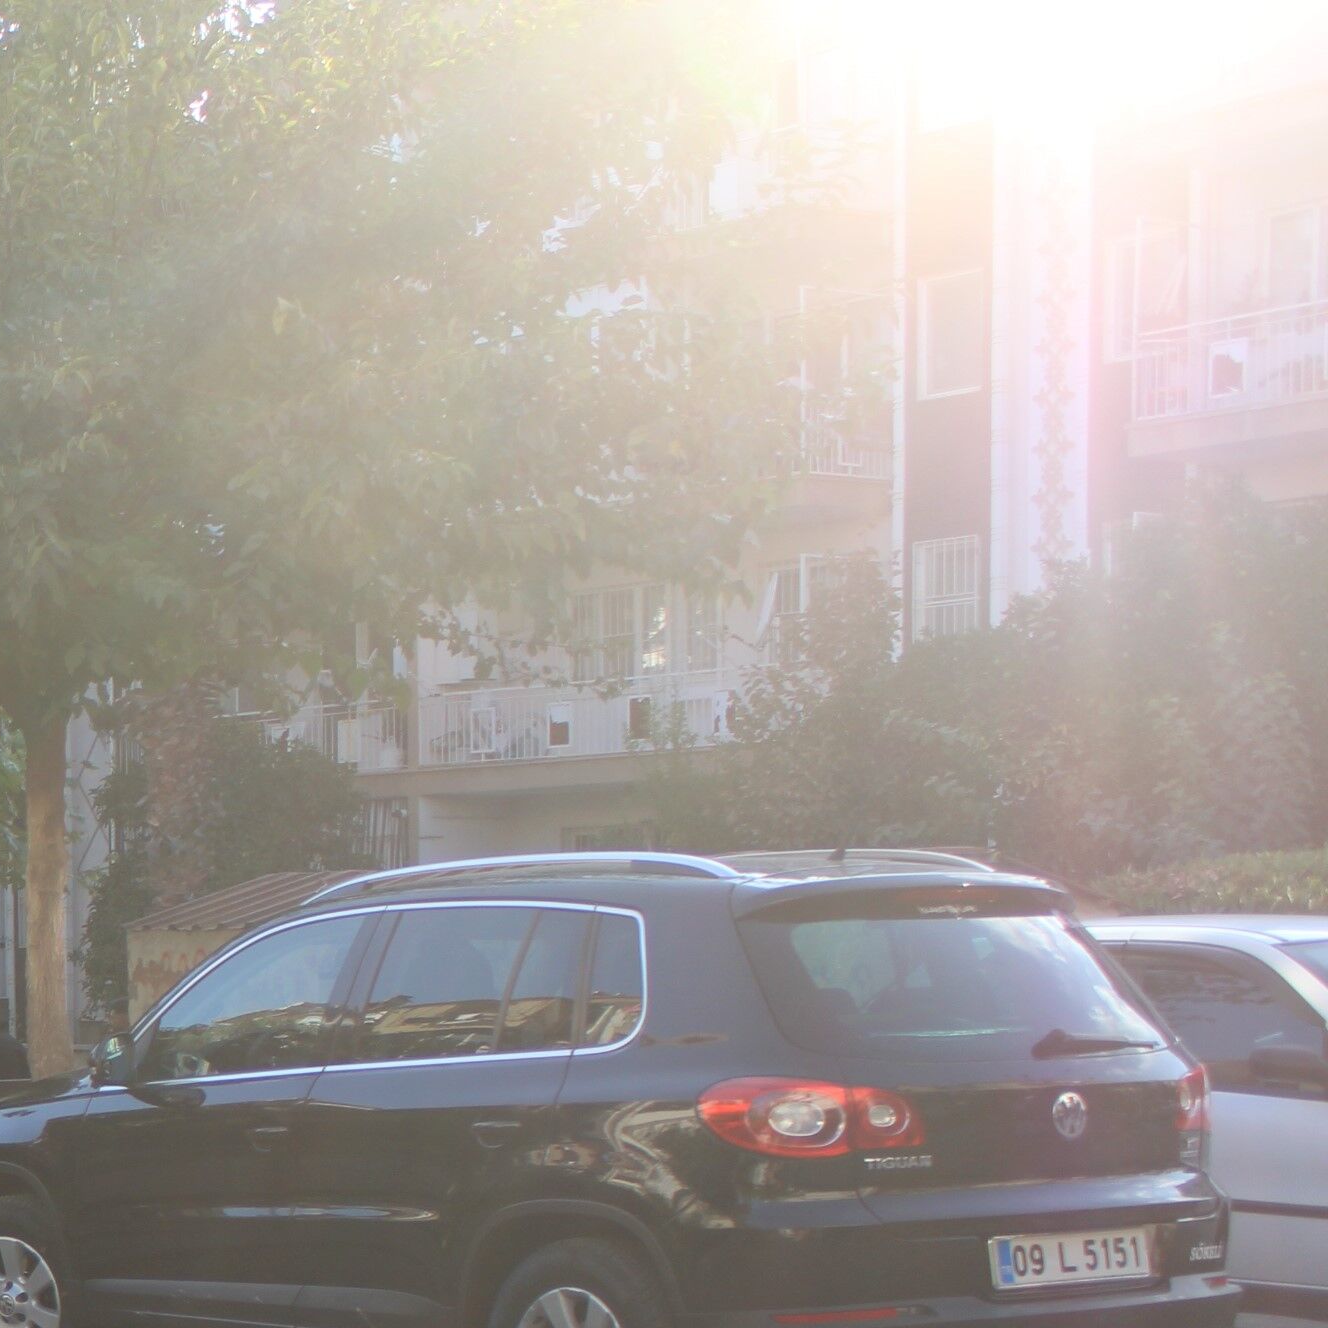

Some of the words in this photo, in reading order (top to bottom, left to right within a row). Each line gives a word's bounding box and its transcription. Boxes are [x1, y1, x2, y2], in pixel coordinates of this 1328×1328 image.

[863, 1154, 933, 1170] TIGUAN
[1013, 1243, 1045, 1277] 09
[1058, 1241, 1077, 1273] L
[1082, 1236, 1141, 1271] 5151
